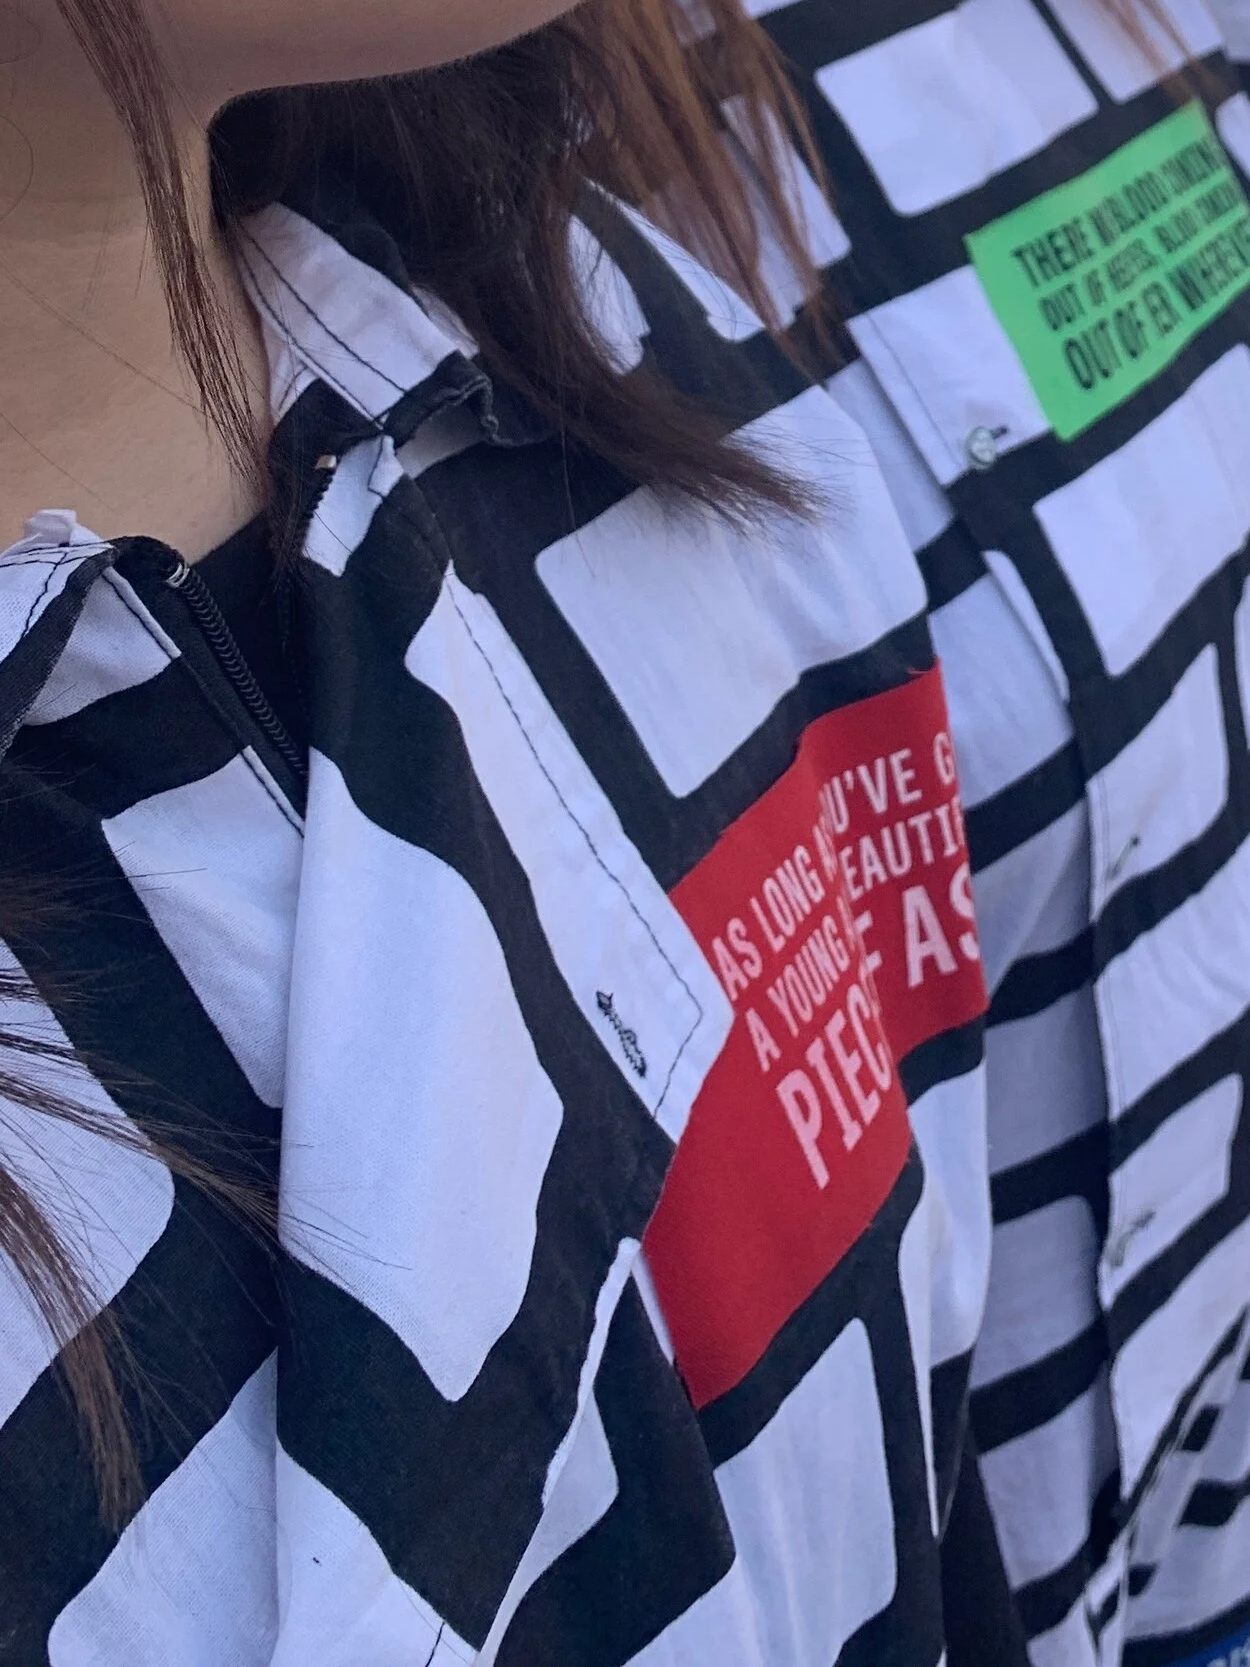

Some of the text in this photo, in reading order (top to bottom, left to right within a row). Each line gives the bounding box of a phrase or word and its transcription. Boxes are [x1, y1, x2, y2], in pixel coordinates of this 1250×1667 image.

[1010, 216, 1096, 287] THERE
[1062, 318, 1123, 391] OUT
[712, 917, 762, 1002] AS
[750, 844, 825, 954] LONG
[745, 1007, 782, 1073] A
[767, 914, 850, 1038] YOUNG
[776, 983, 892, 1191] PIEC
